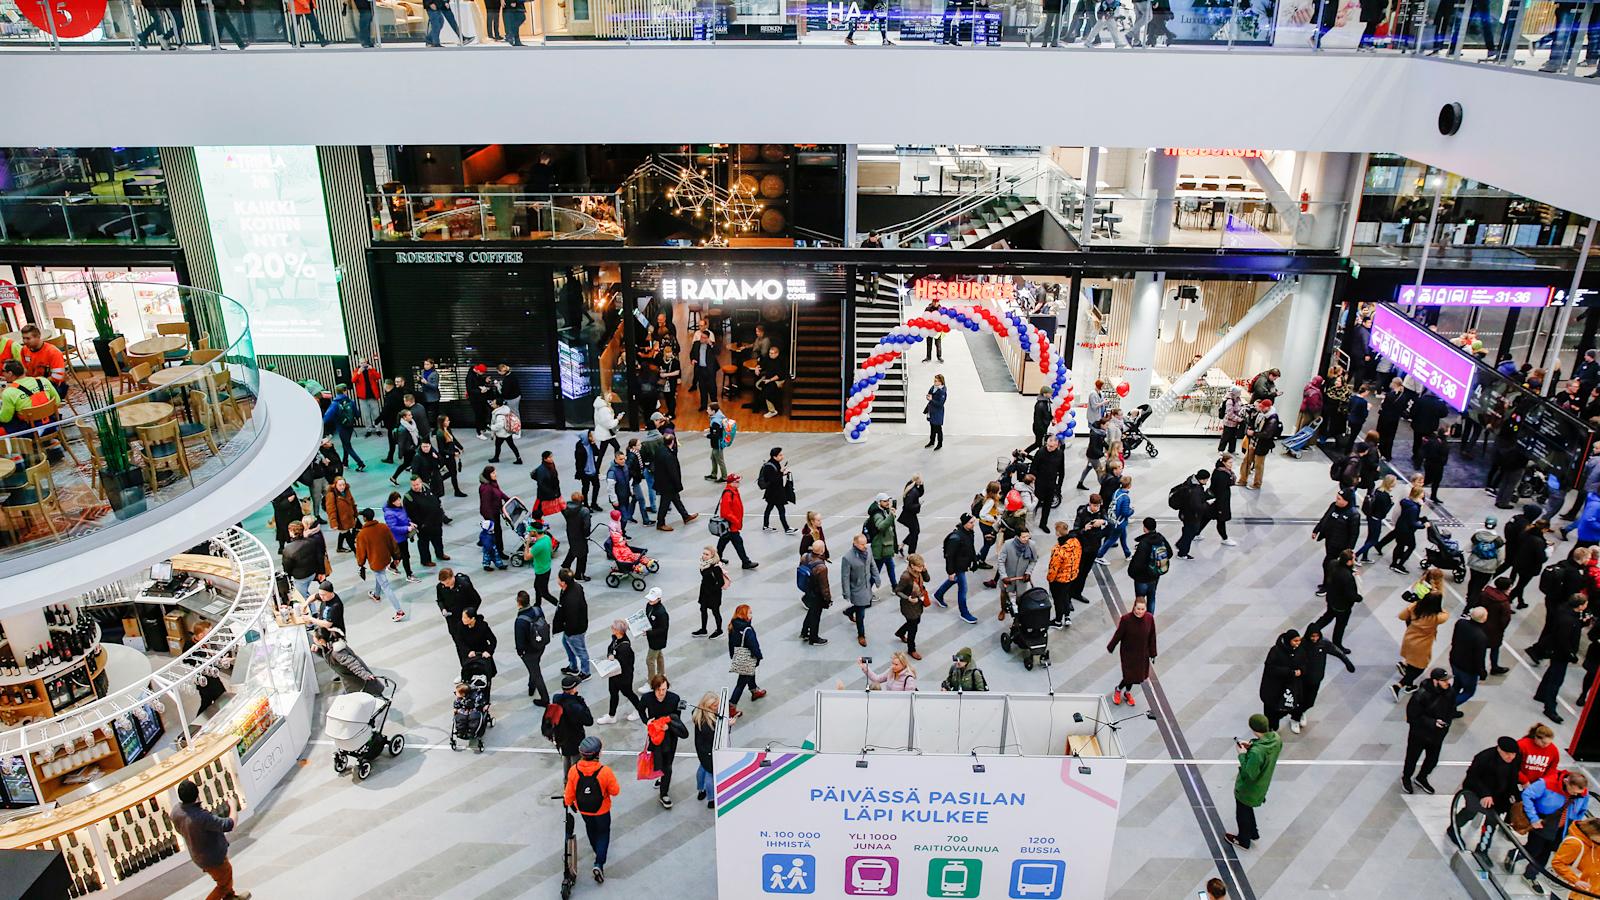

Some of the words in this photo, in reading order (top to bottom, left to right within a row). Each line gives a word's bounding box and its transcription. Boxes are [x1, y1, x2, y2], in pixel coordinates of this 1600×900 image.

[760, 25, 783, 33] REDKEN
[233, 201, 296, 215] KAIKKI
[240, 216, 301, 231] KOTIIN
[252, 233, 288, 247] NYT
[395, 251, 464, 264] ROBERT'S
[469, 251, 523, 264] COFFEE
[233, 252, 316, 279] -20%
[681, 278, 783, 301] RATAMO
[915, 278, 1014, 301] HESBURGER
[786, 293, 816, 301] COFFEE
[1495, 291, 1530, 304] 31-36
[810, 786, 920, 804] PÄIVÄSSÄ
[929, 791, 1026, 806] PASILAN
[844, 805, 893, 822] LÄPI
[902, 809, 989, 824] KULKEE
[760, 831, 771, 839] N.
[774, 831, 794, 840] 100
[797, 832, 821, 840] 000
[849, 833, 866, 841] YLI
[870, 833, 897, 842] 1000
[947, 835, 968, 843] 700
[1028, 837, 1055, 845] 1200
[766, 839, 811, 849] IHMISTÄ
[853, 843, 892, 851] JUNAA
[913, 844, 999, 853] RAITIOVAUNUA
[1020, 846, 1061, 854] BUSSIA
